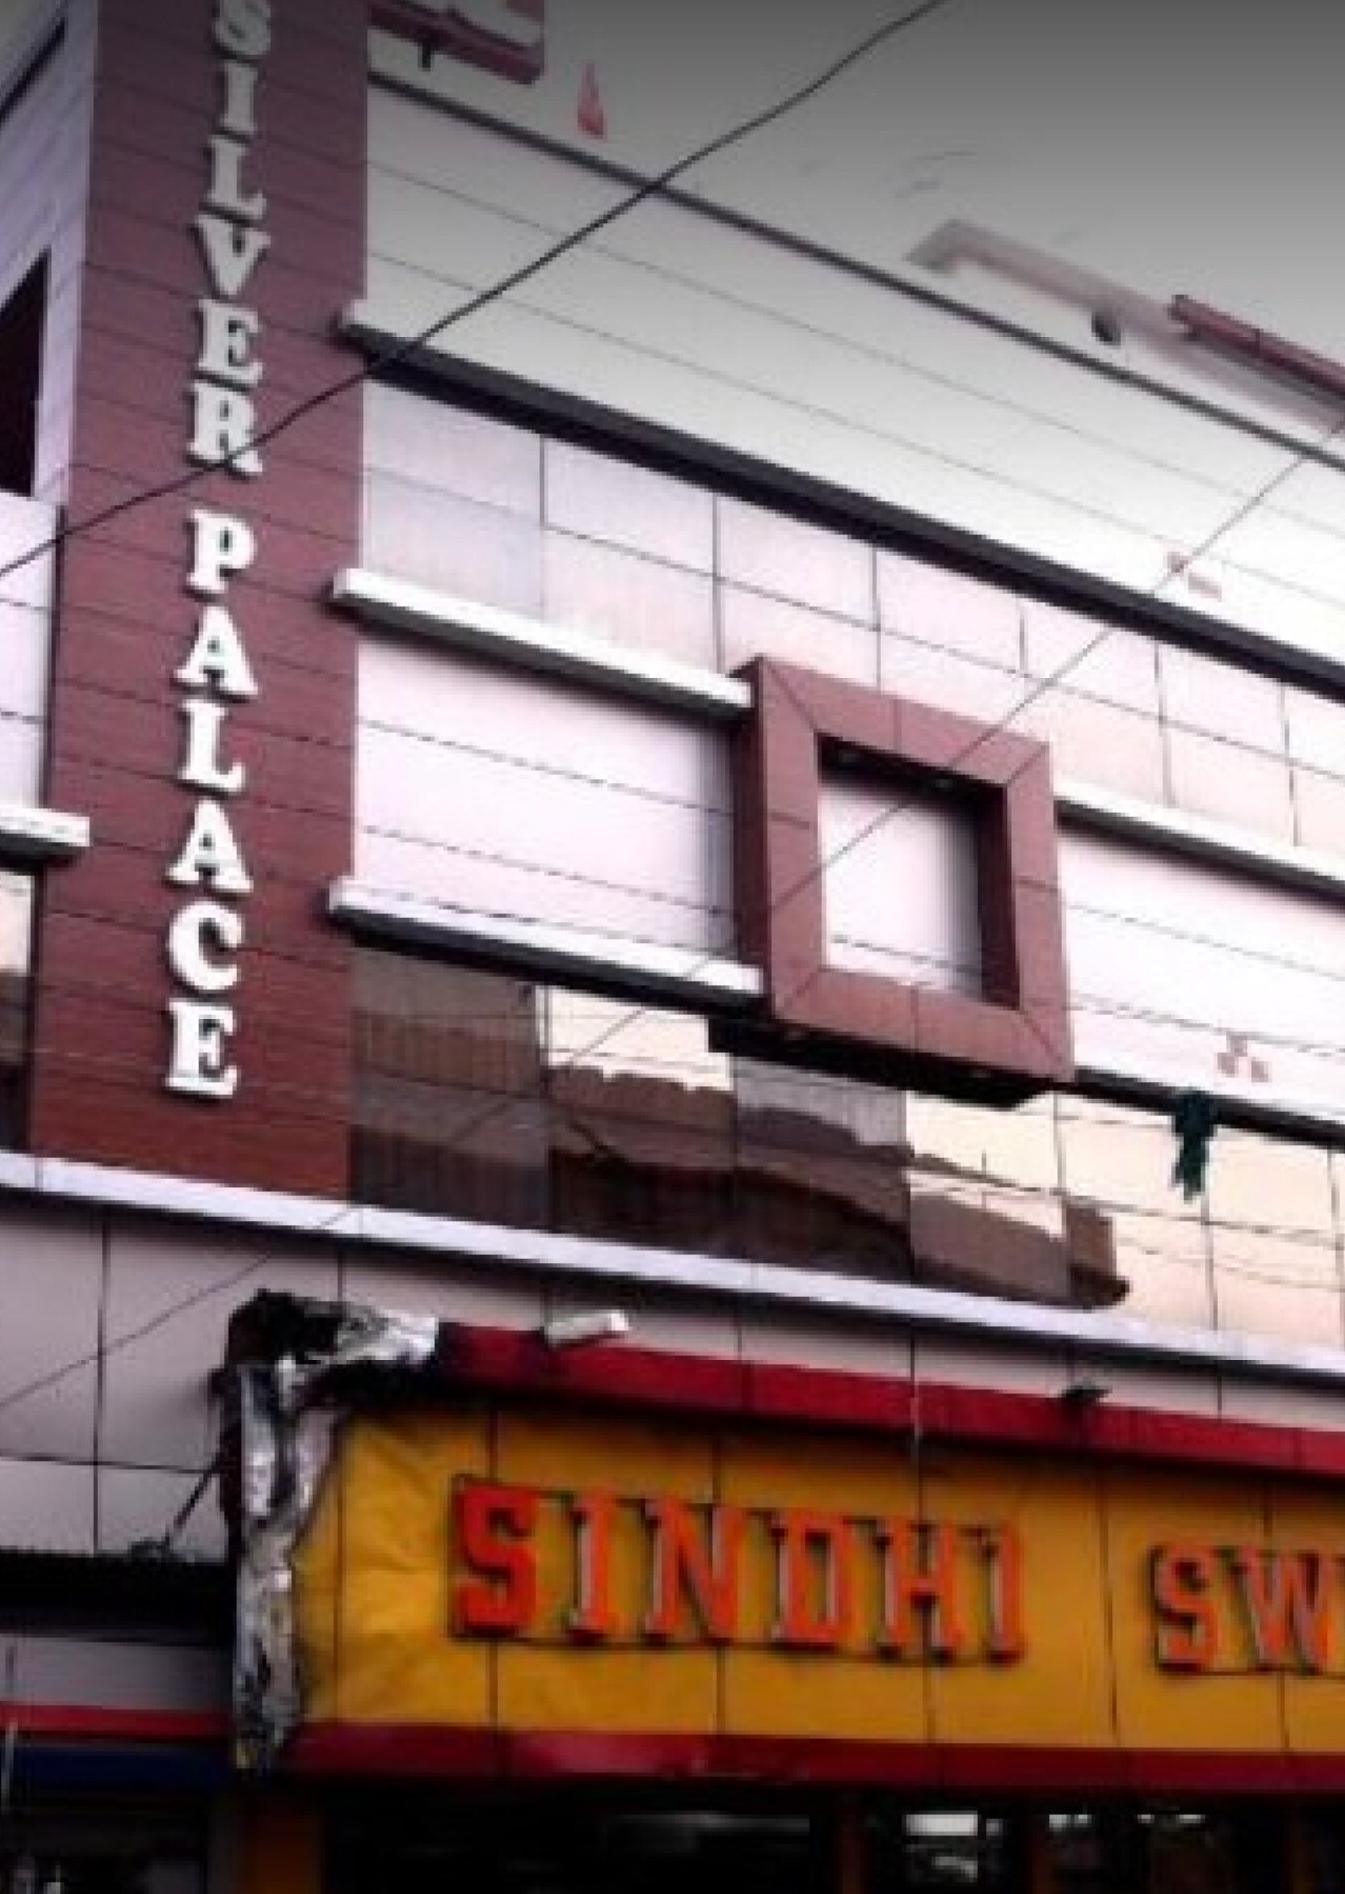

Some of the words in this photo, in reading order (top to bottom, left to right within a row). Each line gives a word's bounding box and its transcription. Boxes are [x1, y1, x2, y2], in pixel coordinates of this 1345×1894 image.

[186, 0, 272, 476] SILVER
[165, 508, 259, 1097] PALACE
[451, 1480, 1024, 1665] SINDHI
